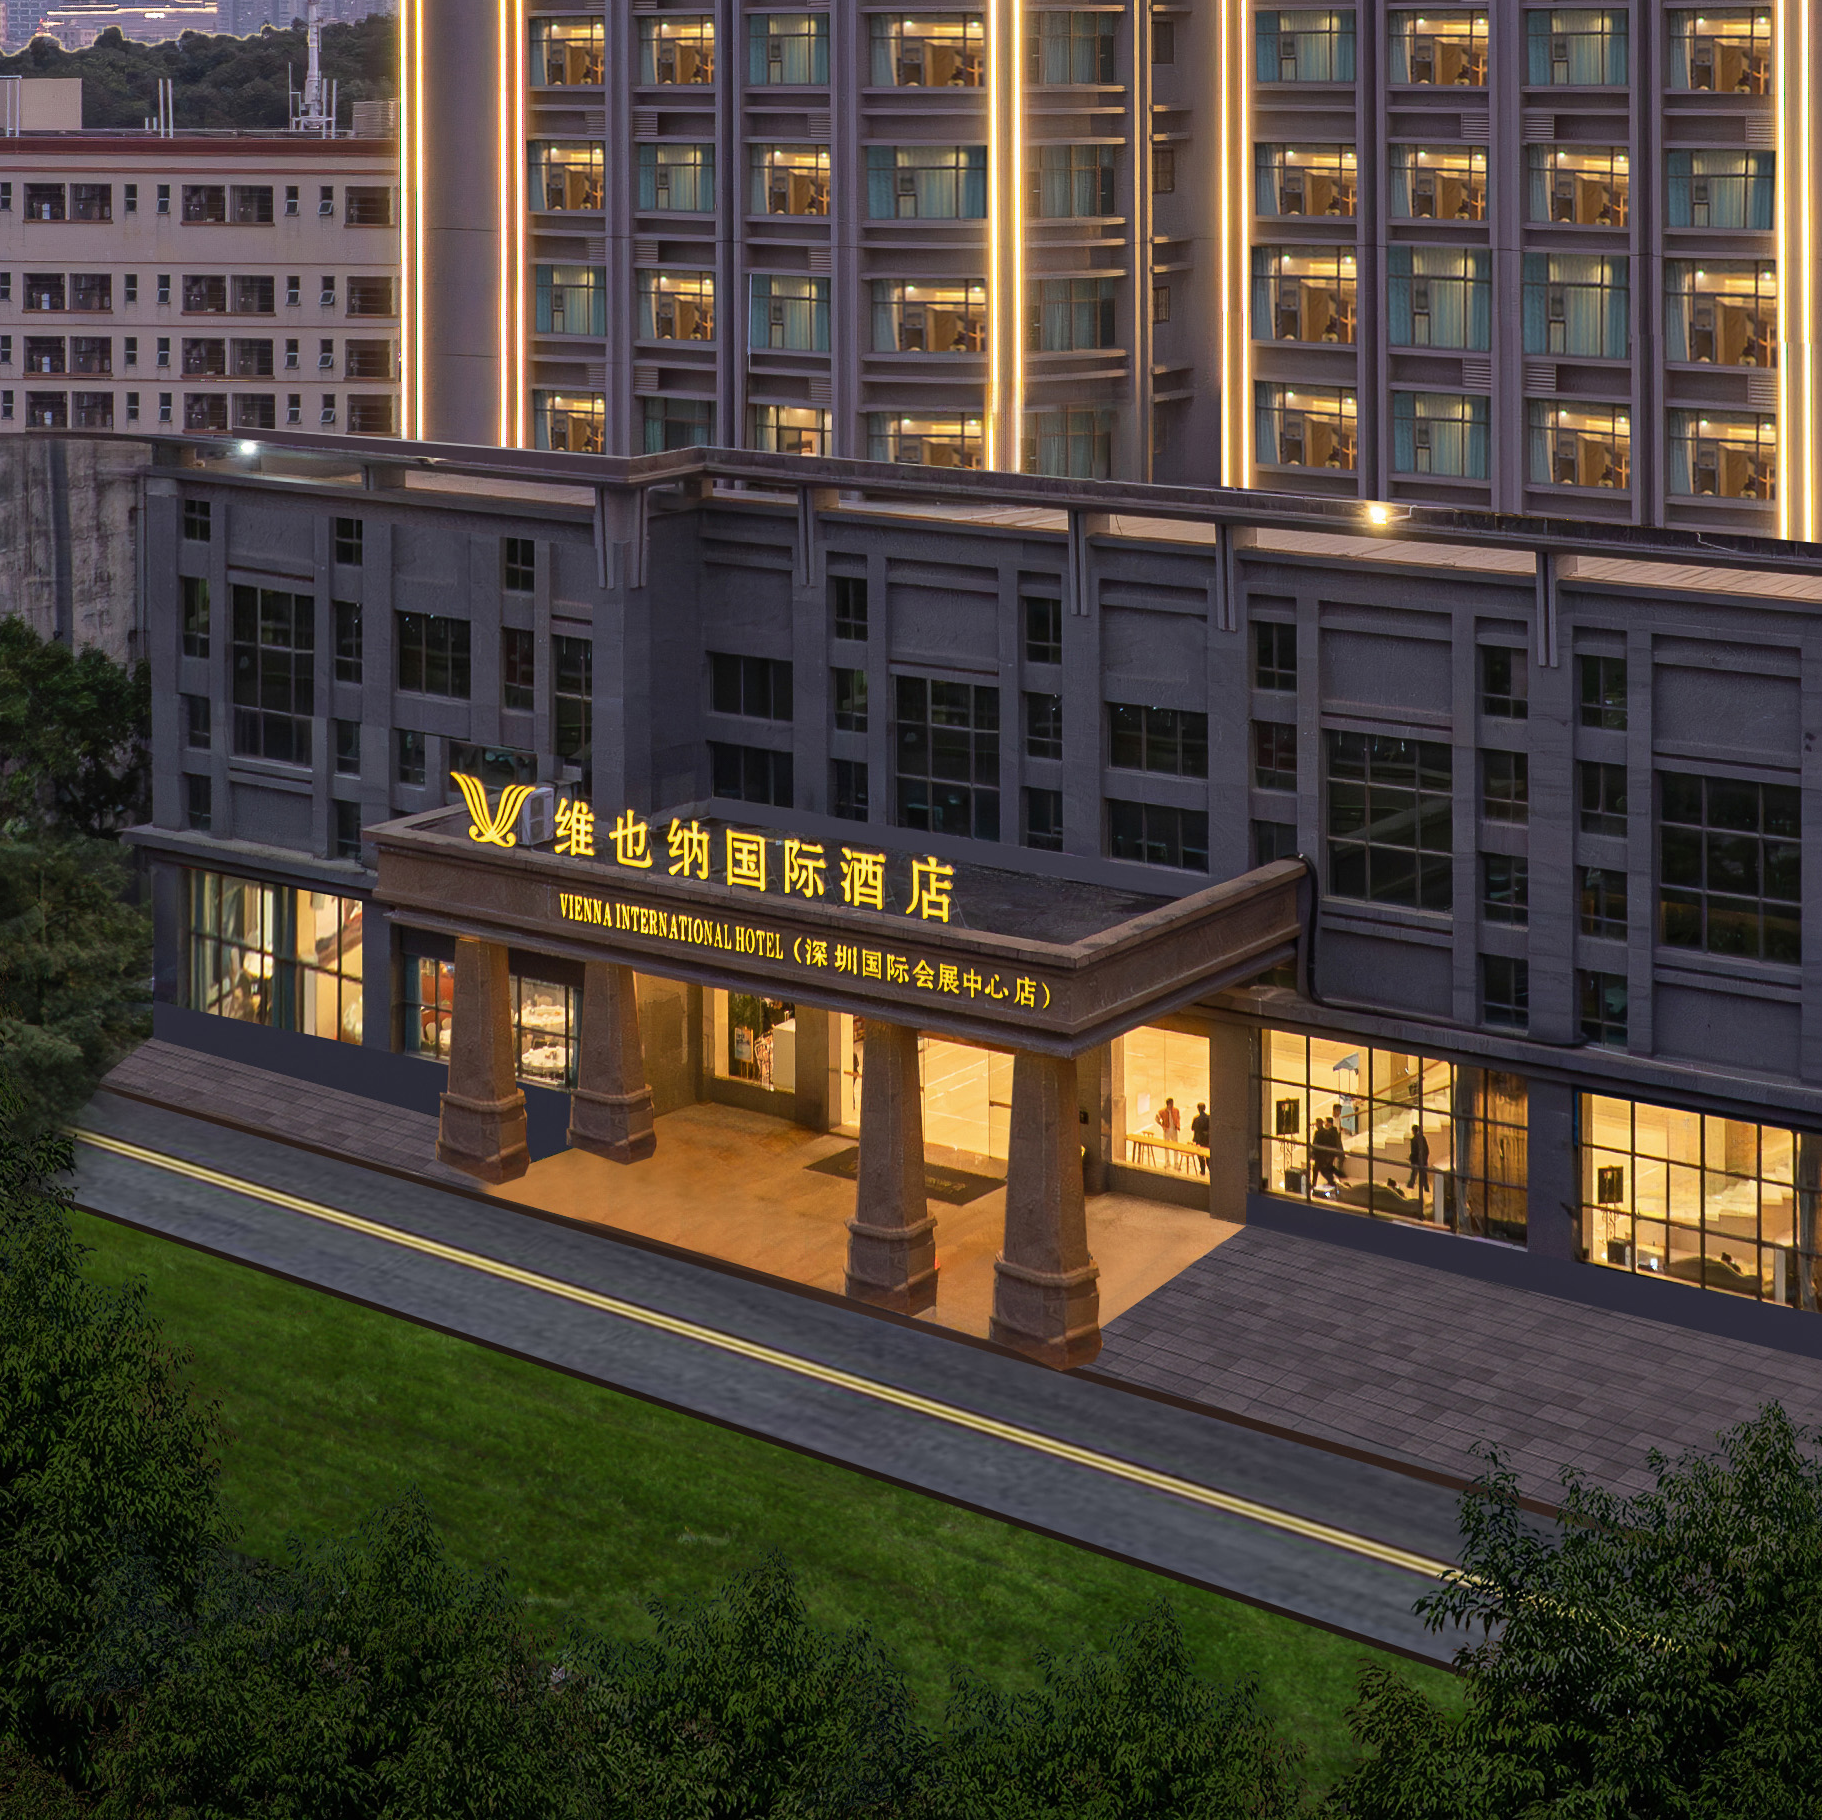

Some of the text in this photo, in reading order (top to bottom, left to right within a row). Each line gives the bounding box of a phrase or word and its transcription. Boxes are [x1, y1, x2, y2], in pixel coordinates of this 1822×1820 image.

[553, 797, 956, 924] 维也纳国际酒店
[559, 892, 613, 928] VIENNA
[615, 902, 733, 950] INTERNATIONAL
[735, 925, 784, 960] HOTEL
